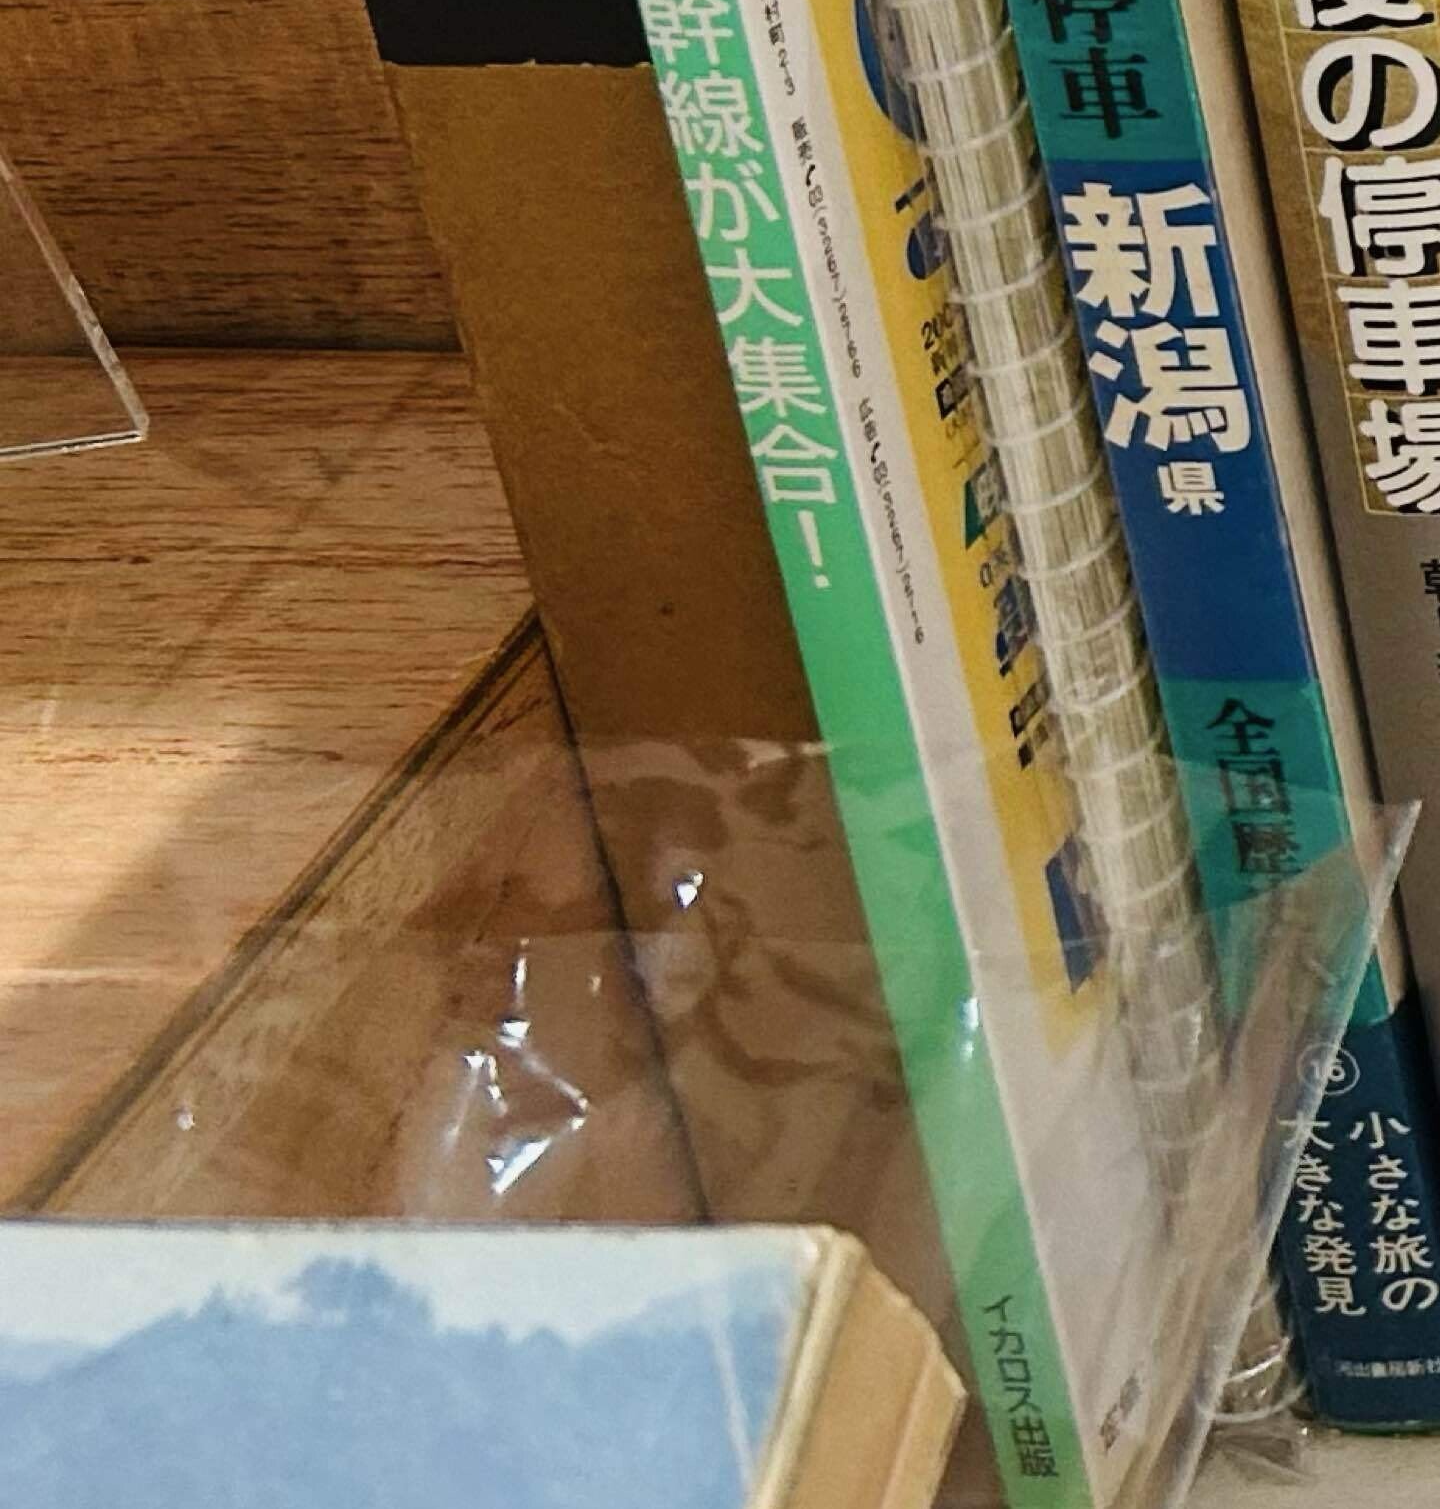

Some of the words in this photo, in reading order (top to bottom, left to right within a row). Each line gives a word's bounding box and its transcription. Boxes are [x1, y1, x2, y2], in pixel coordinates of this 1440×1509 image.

[1060, 181, 1252, 516] 新潟県
[1276, 1111, 1367, 1316] 大きな発見
[1349, 1110, 1440, 1312] 小さな旅の
[982, 1295, 1059, 1479] イカロス出版
